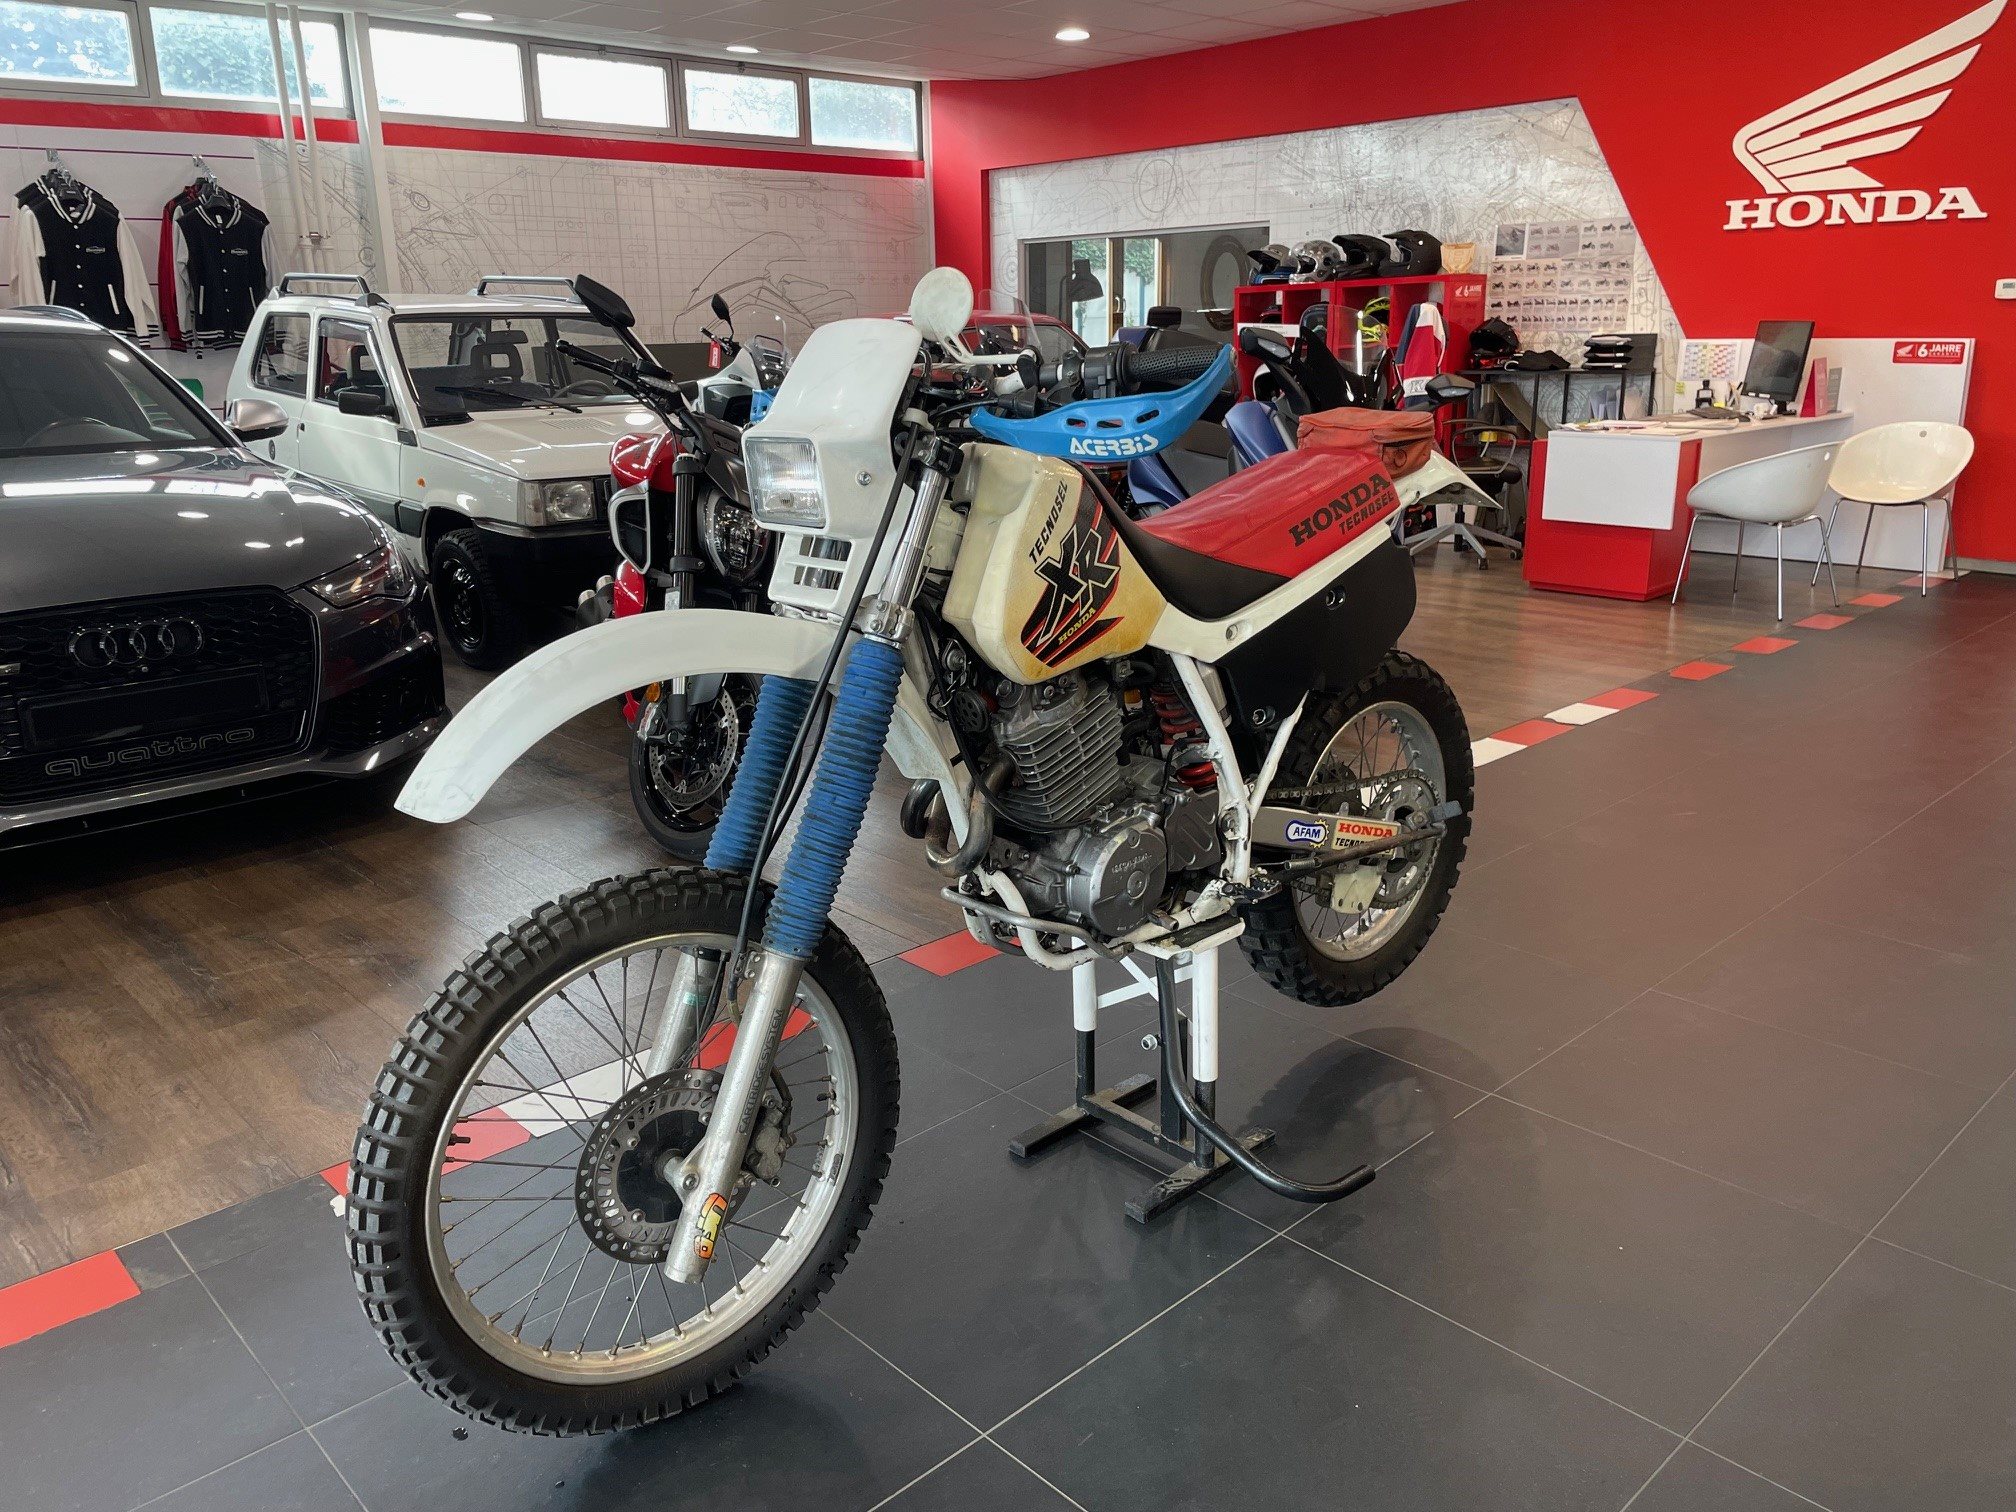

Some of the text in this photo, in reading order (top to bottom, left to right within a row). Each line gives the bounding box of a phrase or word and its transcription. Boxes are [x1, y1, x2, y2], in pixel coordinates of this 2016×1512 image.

[1723, 187, 1988, 231] HONDA
[1917, 344, 1963, 358] 6 JAHRE
[1030, 480, 1068, 565] TECNOSEL
[1289, 473, 1391, 547] HONDA
[1339, 490, 1395, 535] TECNOSEL
[1034, 523, 1121, 648] XR
[1058, 606, 1097, 645] HONDA
[45, 728, 254, 776] quattro
[1292, 826, 1320, 839] AFAM
[1338, 822, 1393, 838] HONDA
[761, 1008, 783, 1061] SYSTEM
